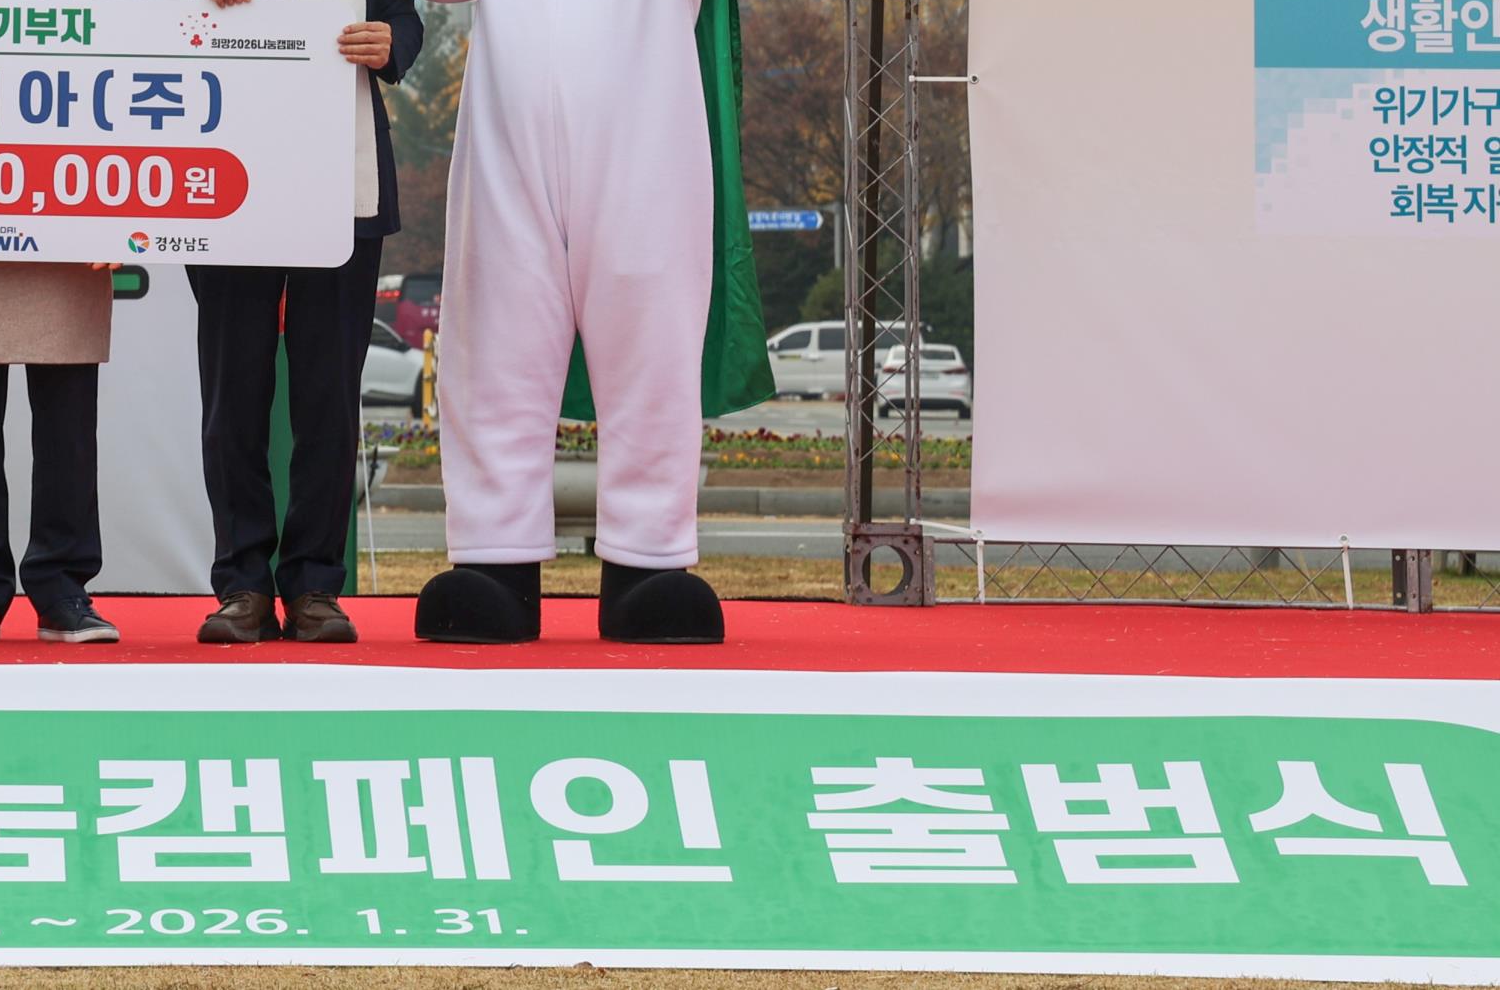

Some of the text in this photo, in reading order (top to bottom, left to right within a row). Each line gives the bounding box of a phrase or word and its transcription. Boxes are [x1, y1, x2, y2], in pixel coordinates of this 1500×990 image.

[211, 38, 306, 50] 희망2026나눔캠페인
[1369, 134, 1467, 175] 안정적
[155, 236, 210, 252] 경상남도
[806, 757, 1469, 887] 출범식
[106, 908, 309, 936] 2026.
[356, 908, 407, 935] 1.
[435, 908, 528, 935] 31.
